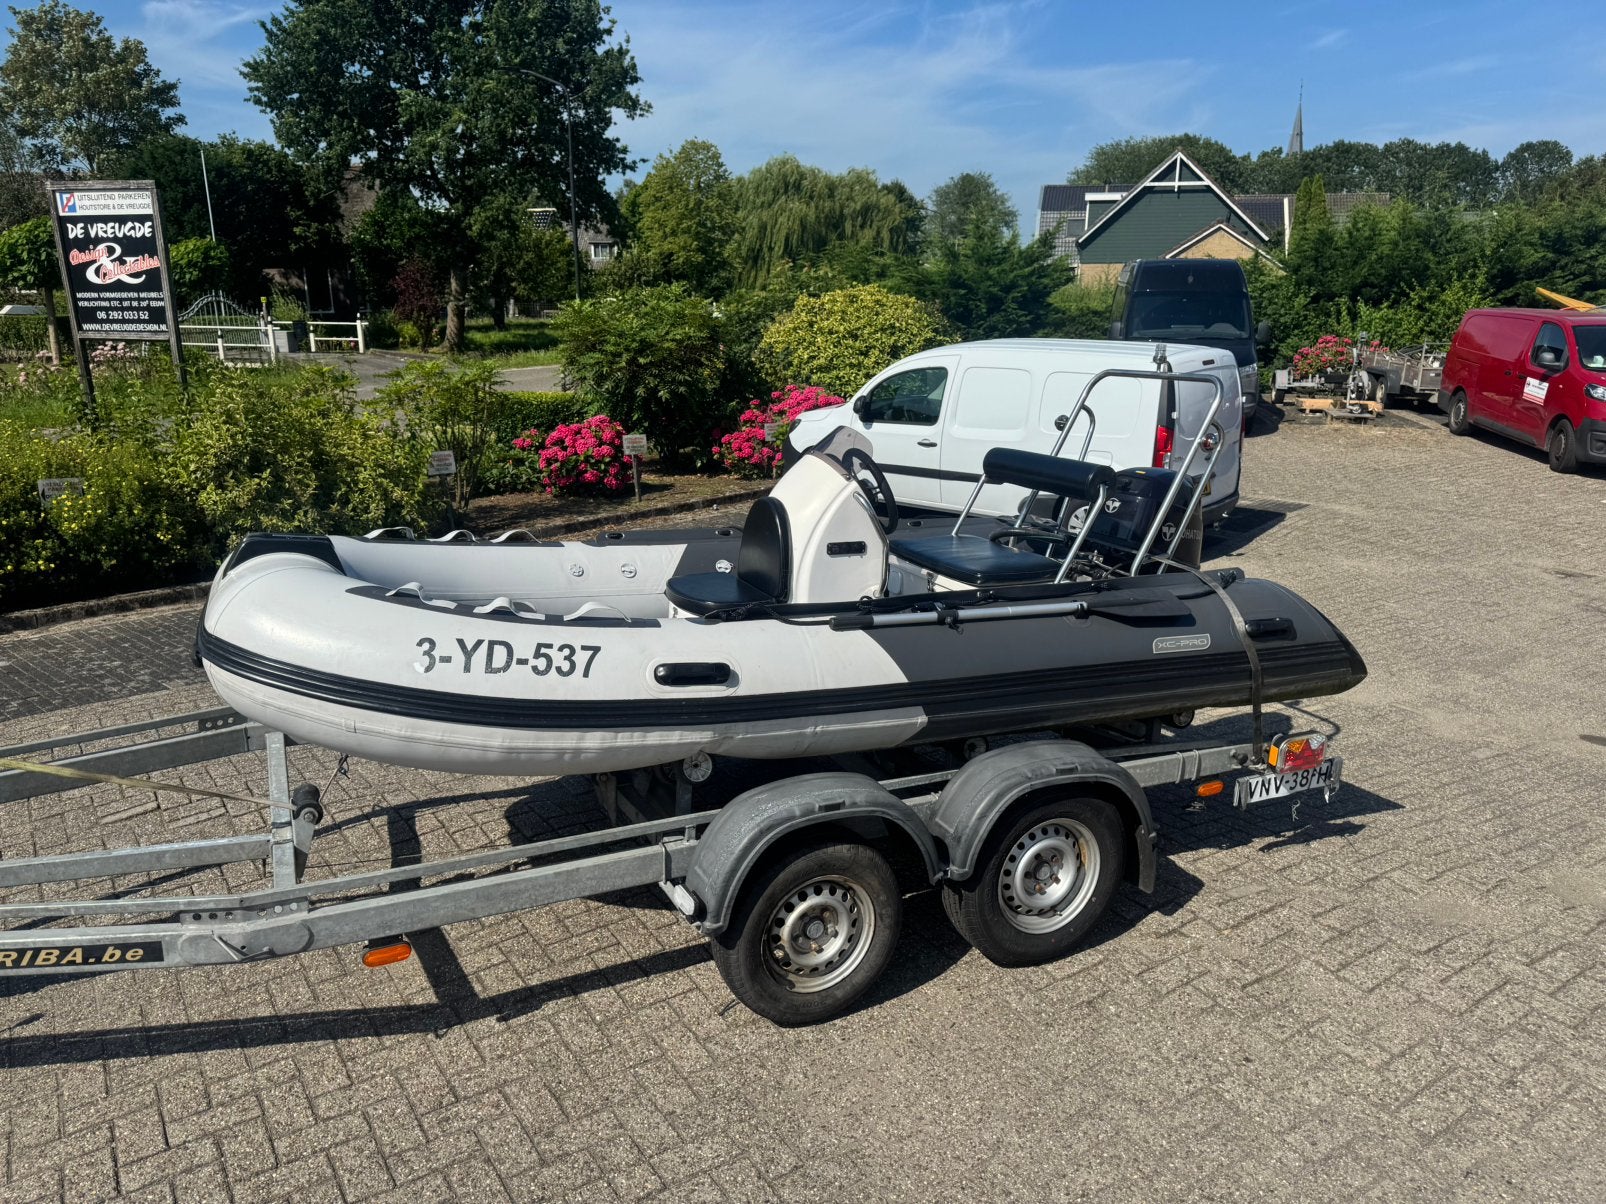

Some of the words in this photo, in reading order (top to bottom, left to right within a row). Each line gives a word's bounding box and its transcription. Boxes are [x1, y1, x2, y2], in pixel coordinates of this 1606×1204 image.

[77, 193, 116, 202] UITSLUITEND
[117, 192, 151, 200] PARKEREN
[126, 202, 151, 210] VREUGDE
[66, 223, 85, 239] DE
[87, 221, 153, 238] VREUGDE
[69, 245, 109, 265] Design
[99, 254, 161, 283] Collectables
[96, 311, 107, 319] 06
[108, 311, 123, 319] 292
[123, 311, 138, 319] 033
[139, 311, 149, 319] 52
[82, 323, 168, 331] WWW.DEVREUGDEDESIGN.NL
[1157, 638, 1208, 649] XC-PRO
[413, 637, 602, 679] 3-YD-537
